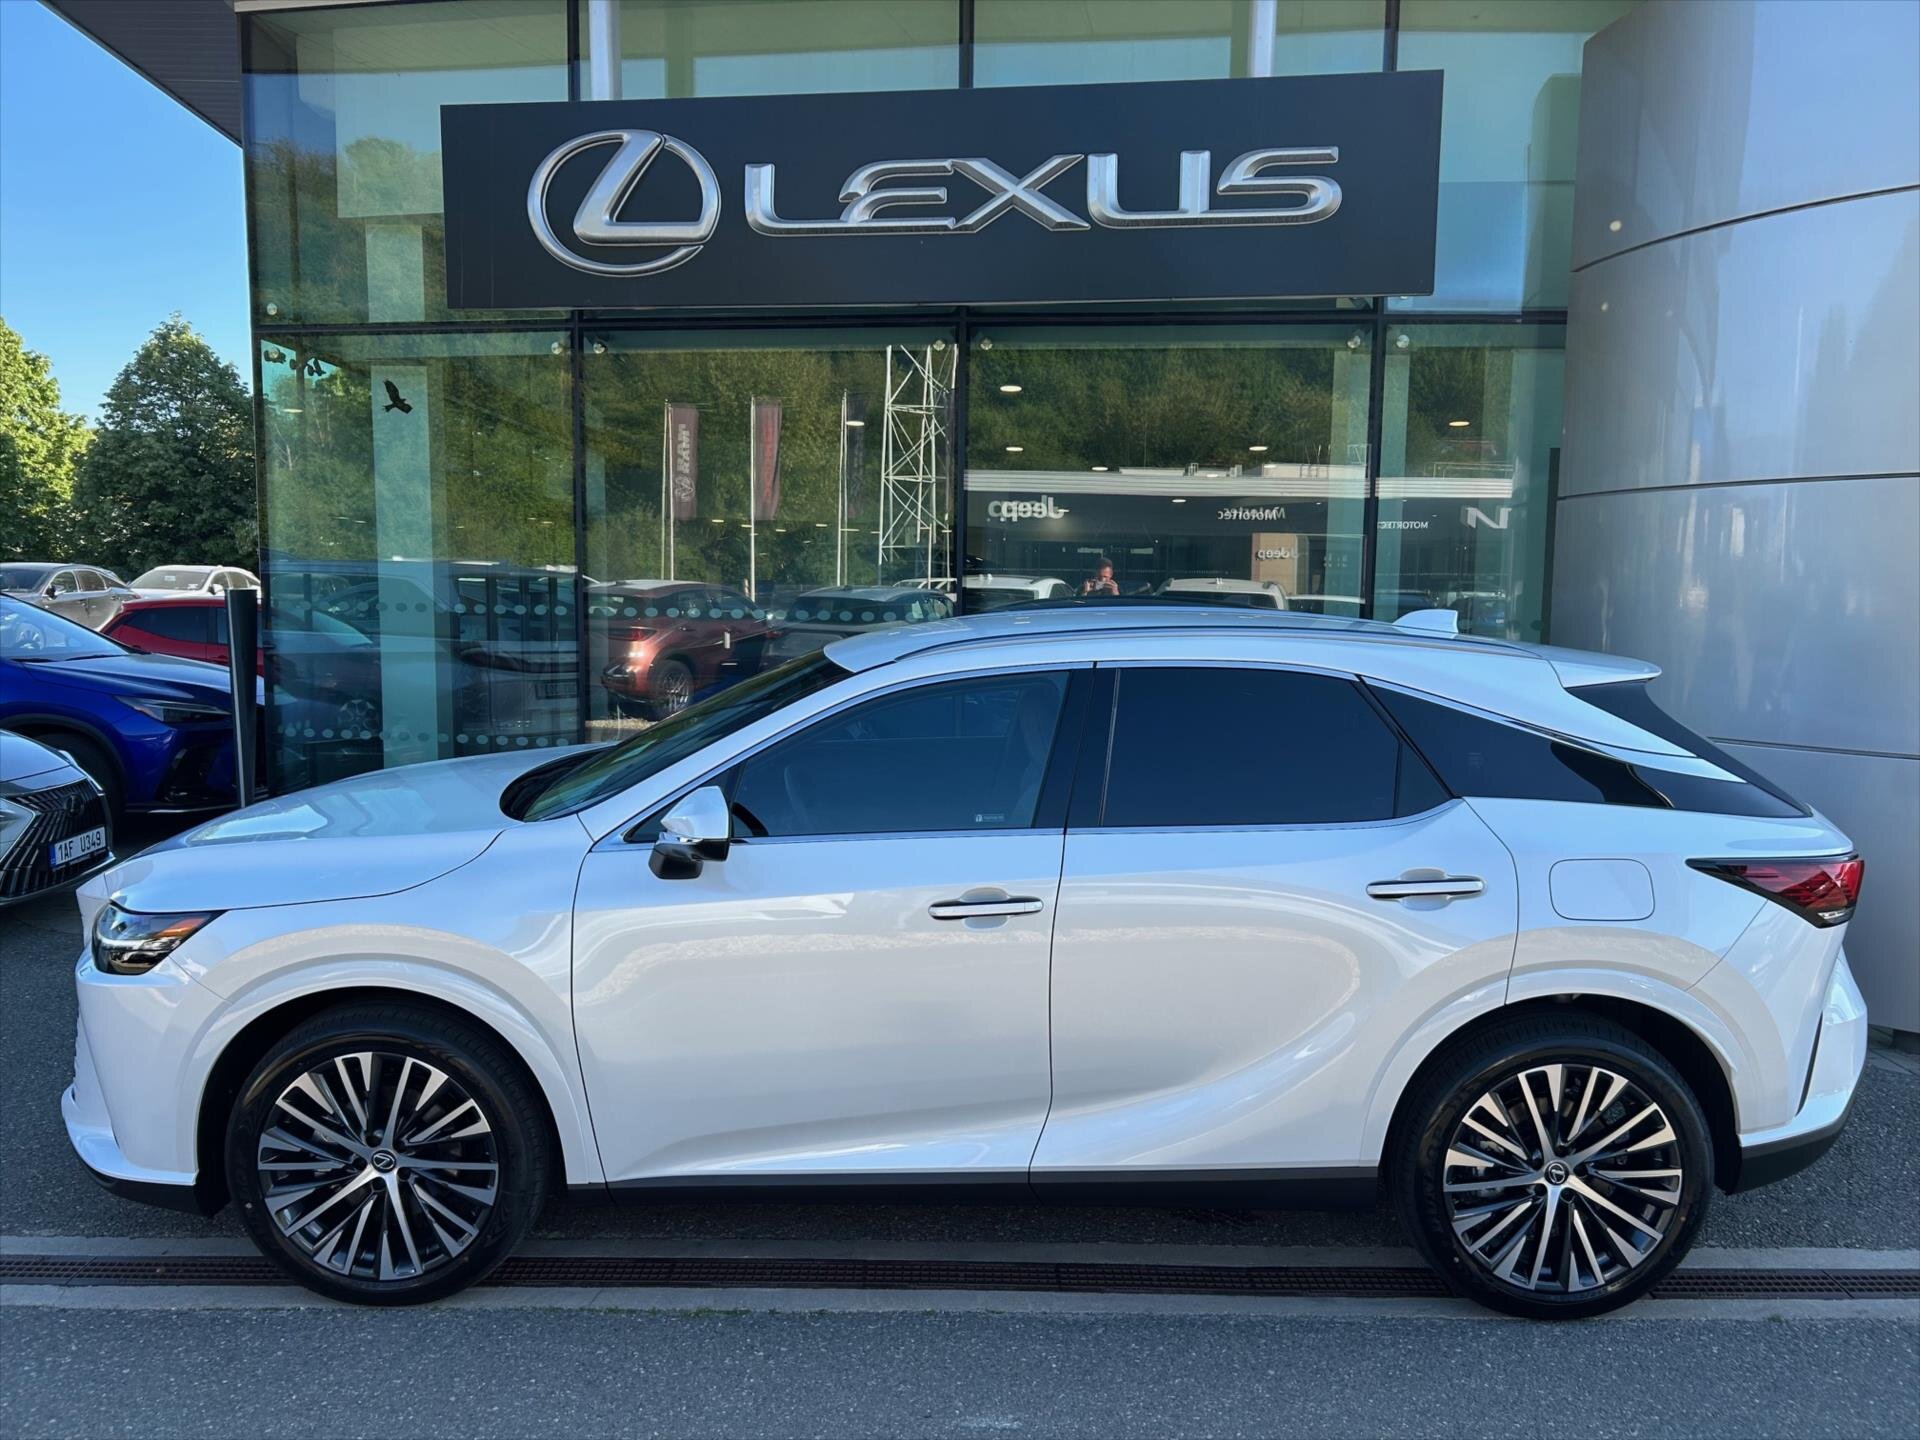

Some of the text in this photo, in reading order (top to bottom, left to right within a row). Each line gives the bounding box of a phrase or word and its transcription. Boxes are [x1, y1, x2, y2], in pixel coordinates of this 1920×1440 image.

[743, 146, 1343, 235] LEXUS
[58, 830, 102, 861] 1AF U349
